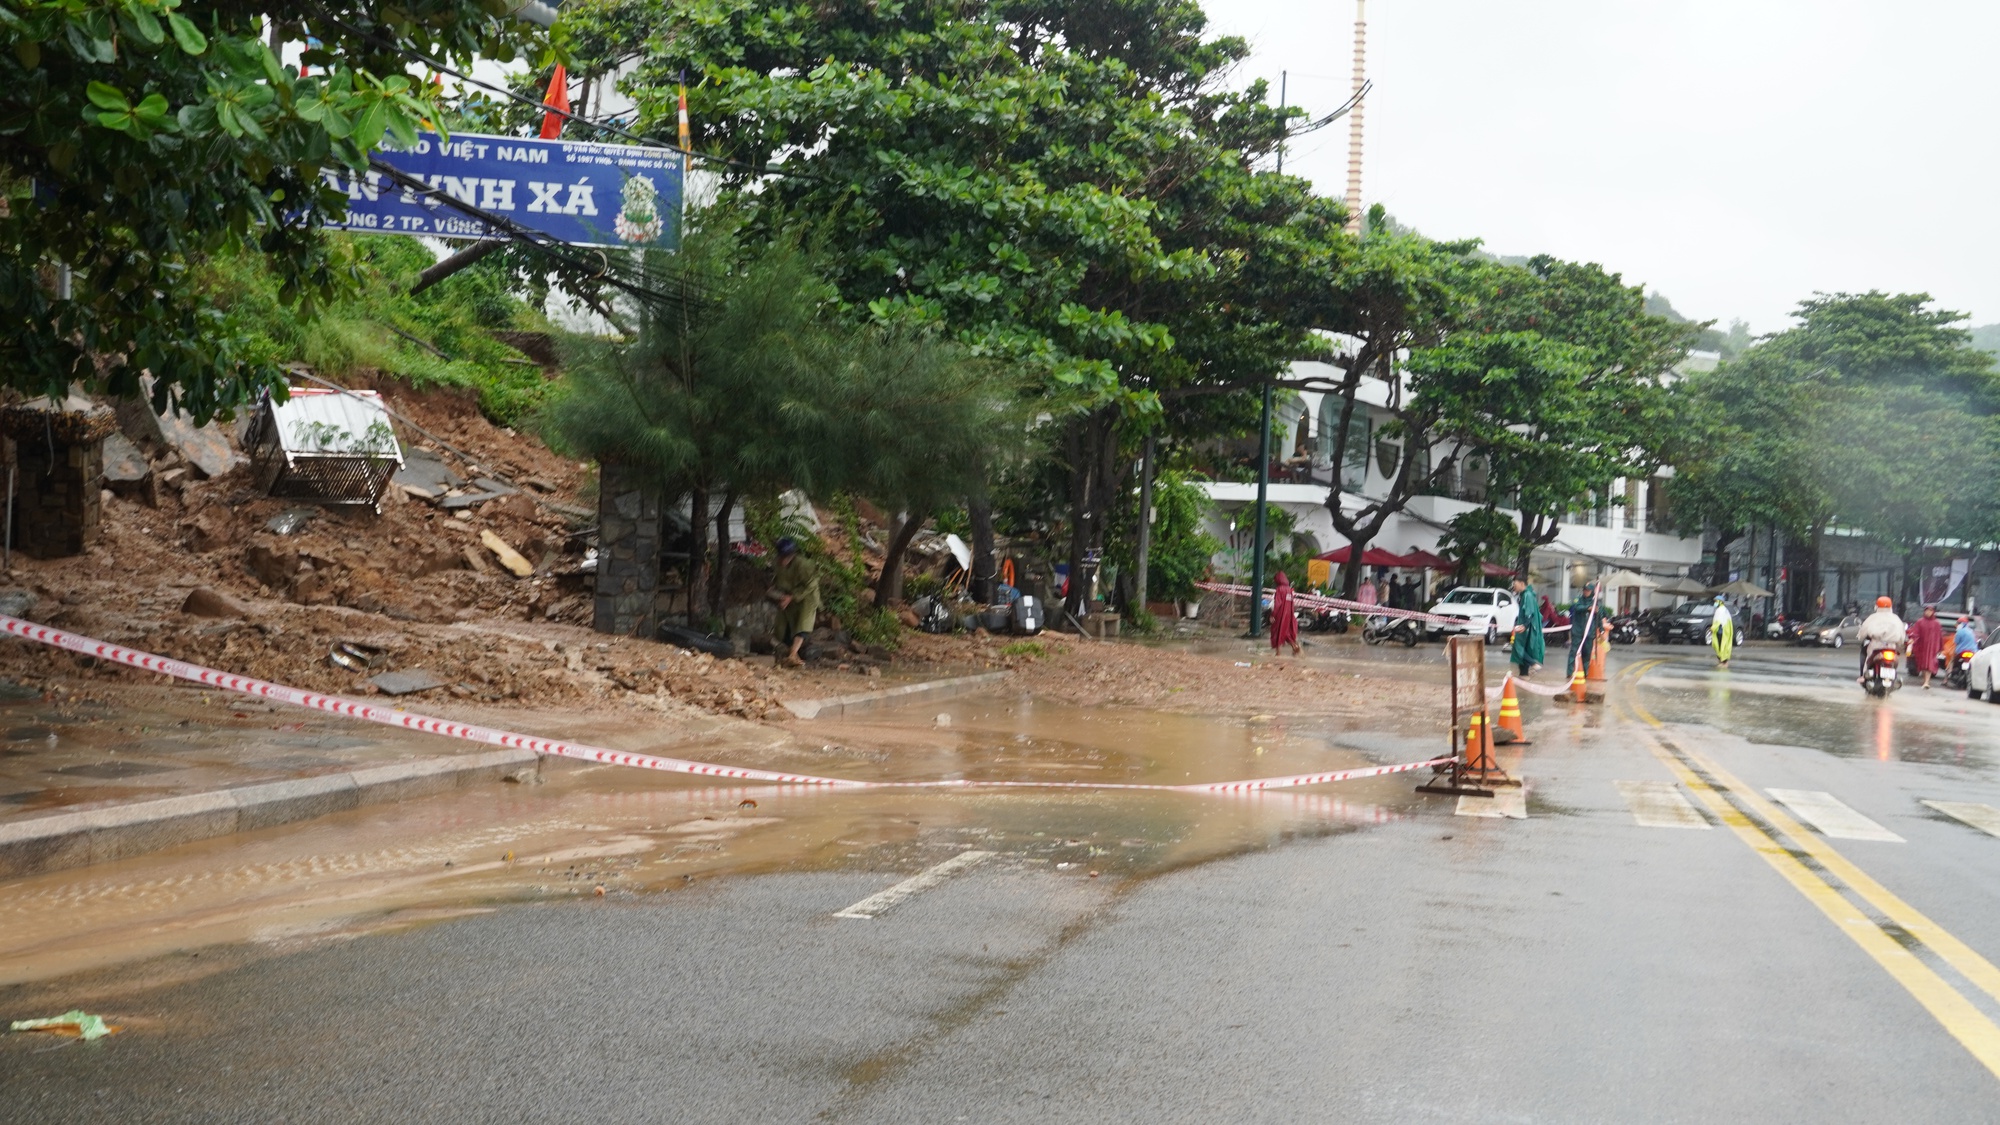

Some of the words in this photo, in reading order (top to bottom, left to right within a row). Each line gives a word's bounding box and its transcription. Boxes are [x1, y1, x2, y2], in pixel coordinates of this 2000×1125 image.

[438, 140, 489, 162] VIỆT
[497, 146, 549, 164] NAM
[527, 176, 599, 216] XÁ
[383, 214, 395, 229] 2
[400, 216, 429, 231] TP.
